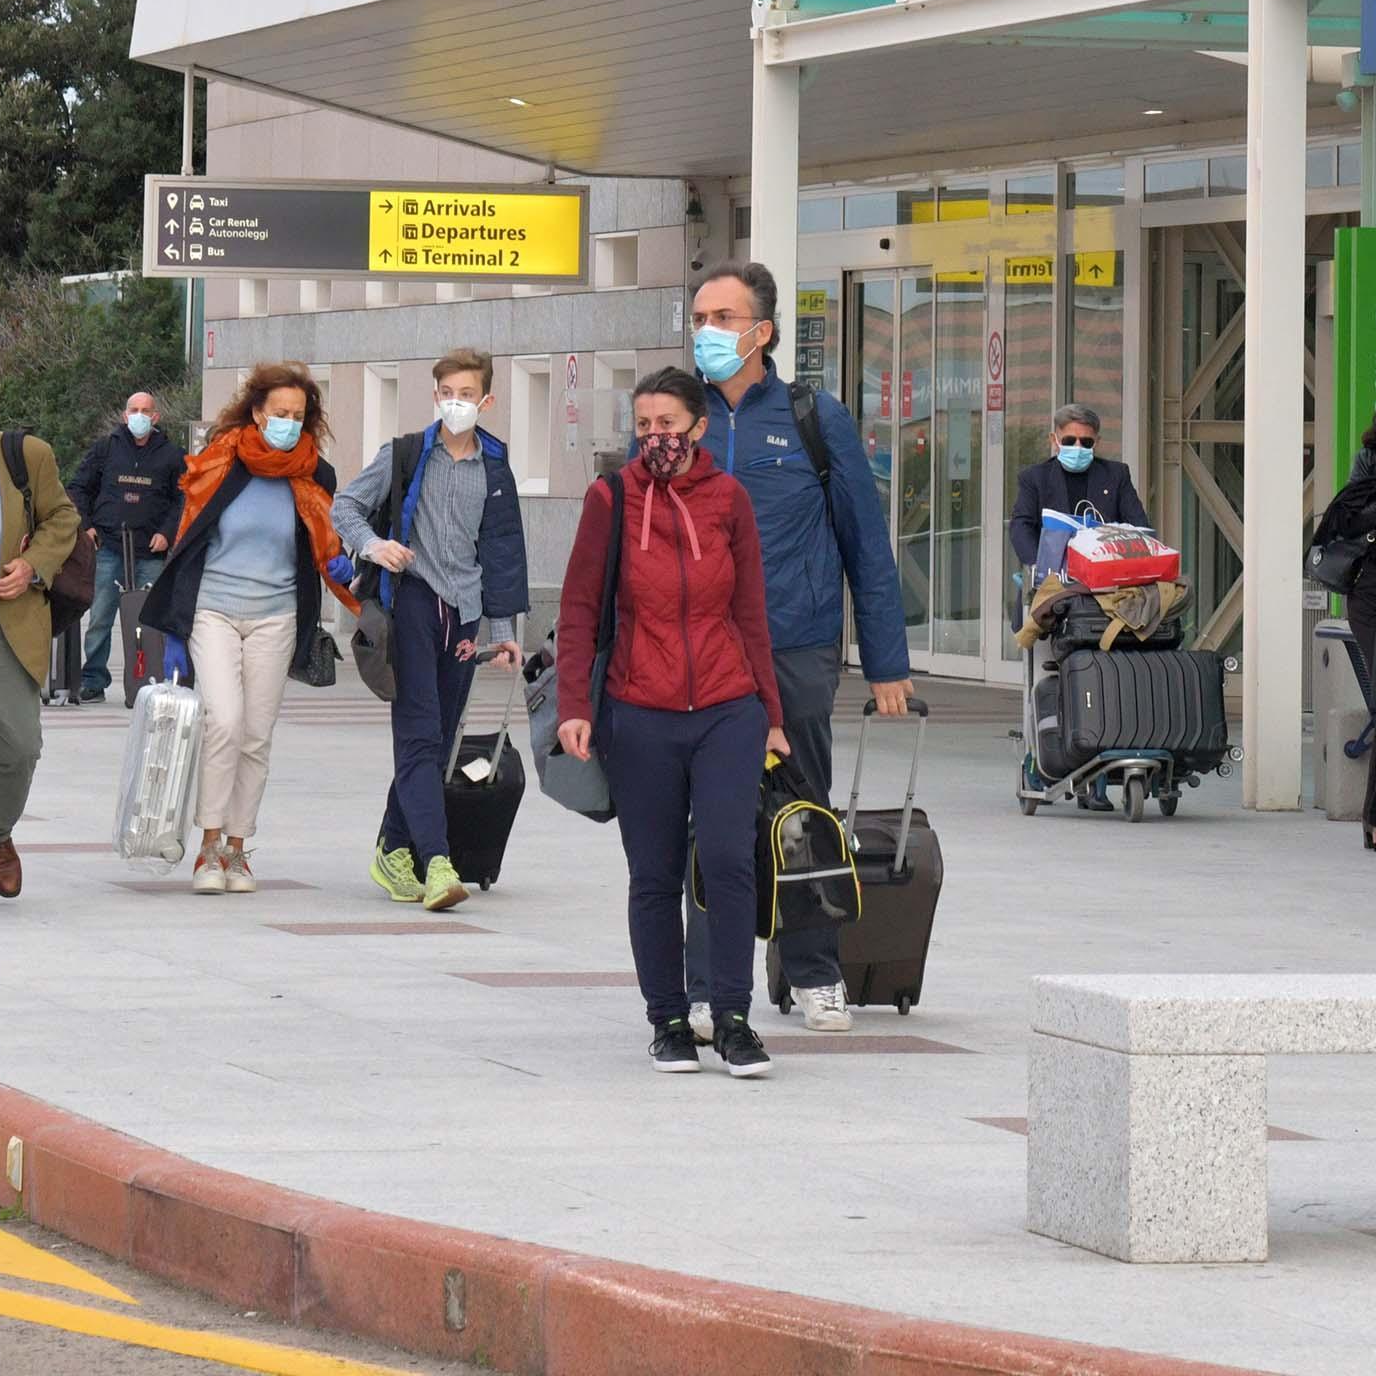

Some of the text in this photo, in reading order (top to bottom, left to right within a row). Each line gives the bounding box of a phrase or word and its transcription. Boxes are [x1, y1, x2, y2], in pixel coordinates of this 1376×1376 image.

[209, 197, 228, 207] Taxi
[423, 199, 496, 217] Arrivals
[209, 217, 259, 228] Car Rental
[209, 229, 269, 240] Autonoleggi
[421, 223, 526, 244] Departures
[207, 247, 225, 257] Bus
[422, 249, 503, 267] Terminal
[509, 251, 520, 267] 2
